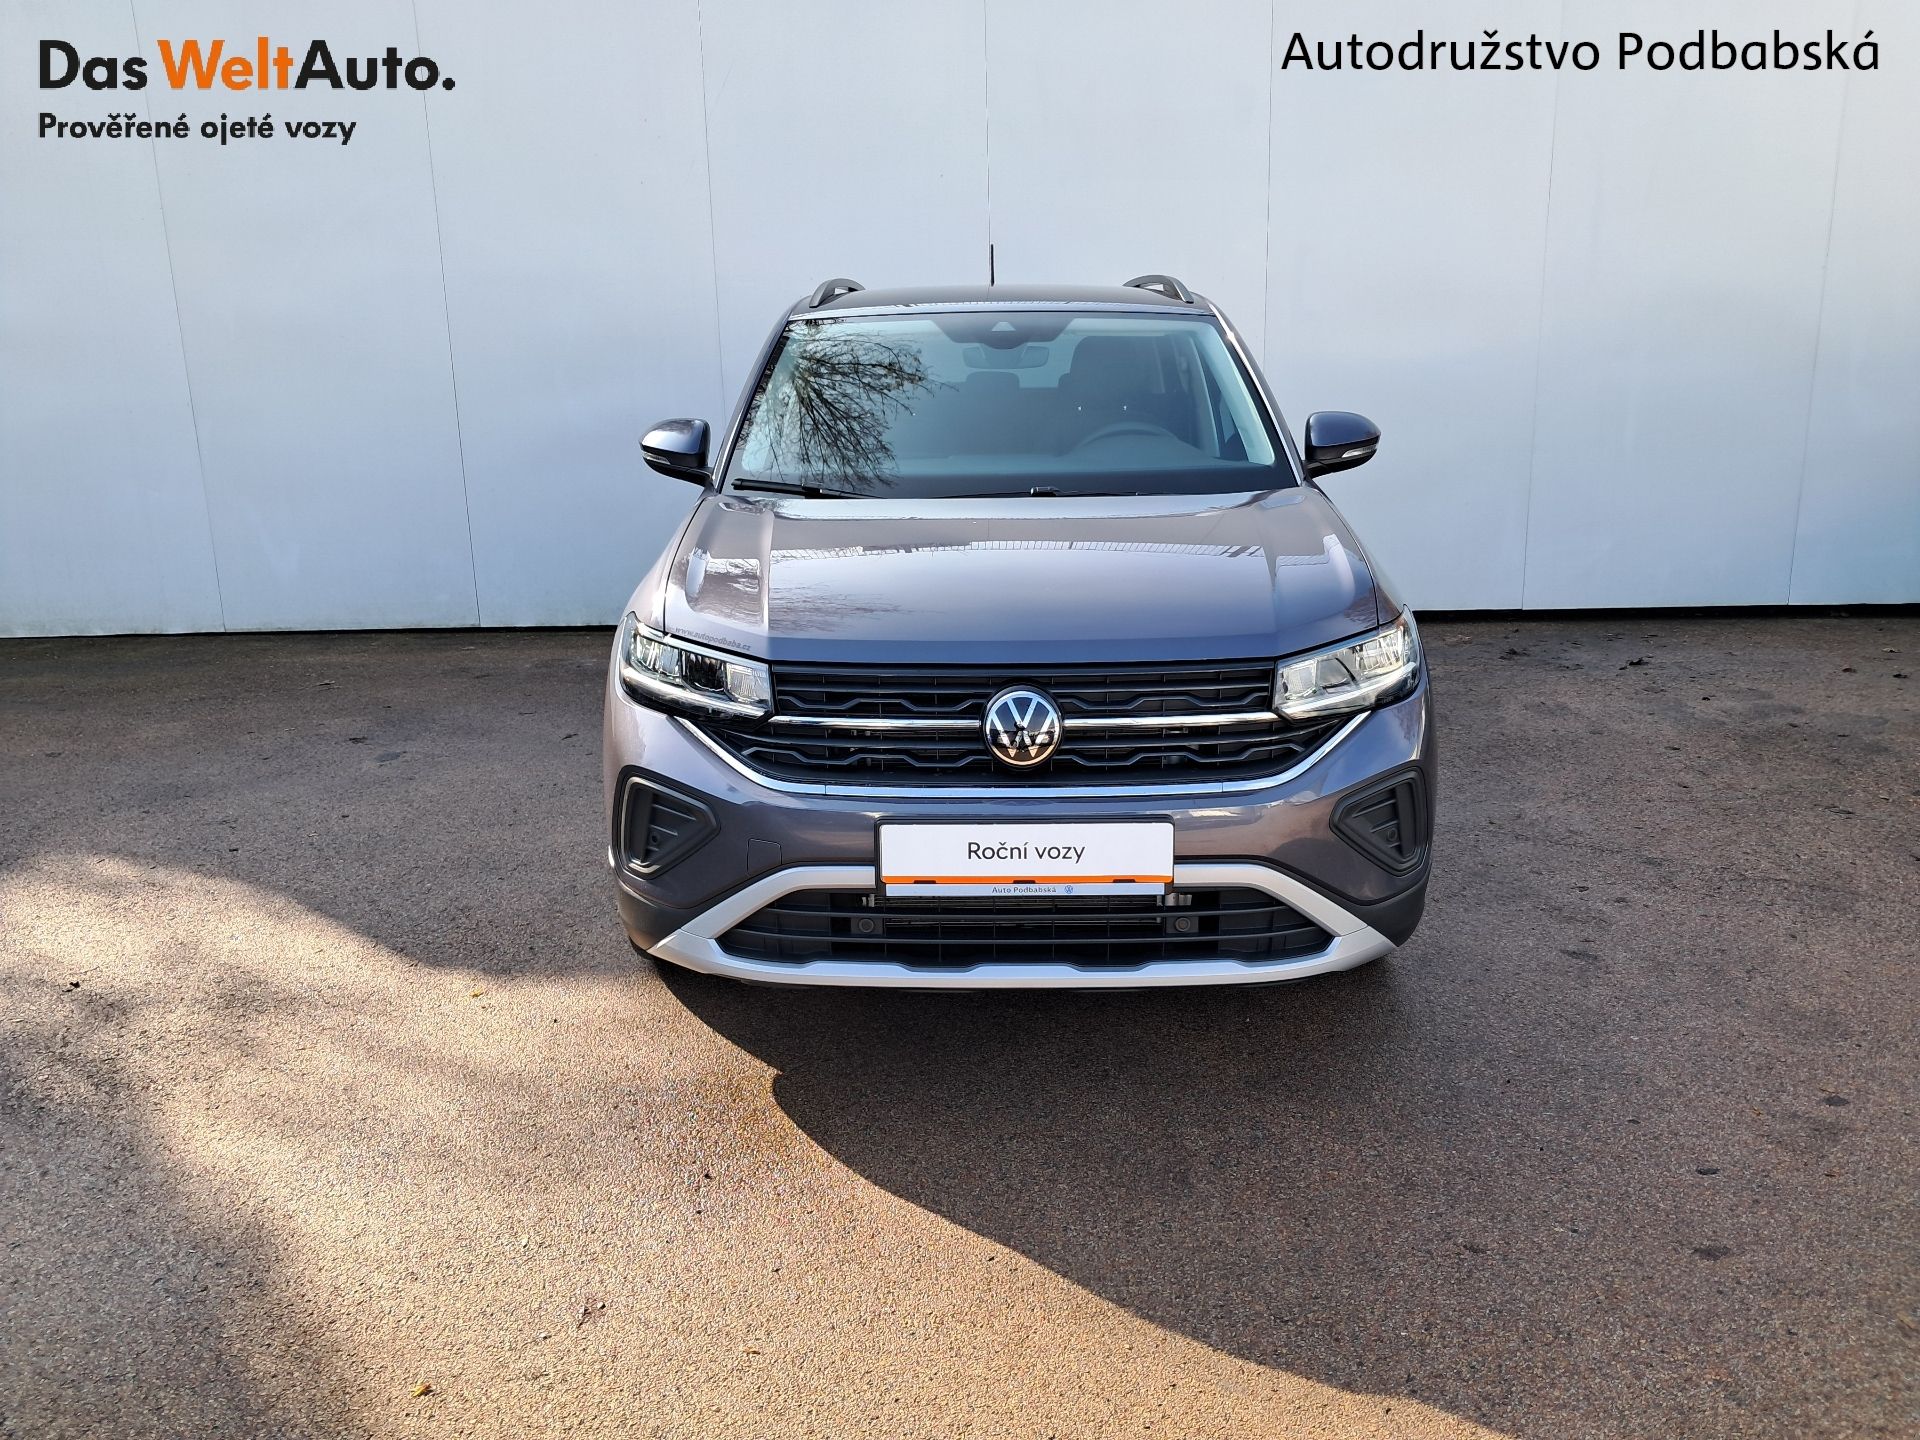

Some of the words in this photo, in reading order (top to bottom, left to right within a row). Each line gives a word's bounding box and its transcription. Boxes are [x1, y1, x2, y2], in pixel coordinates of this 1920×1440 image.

[967, 841, 1029, 860] Roční
[1034, 846, 1086, 864] vozy
[992, 886, 1012, 894] Auto
[1013, 886, 1057, 894] Podbabská
